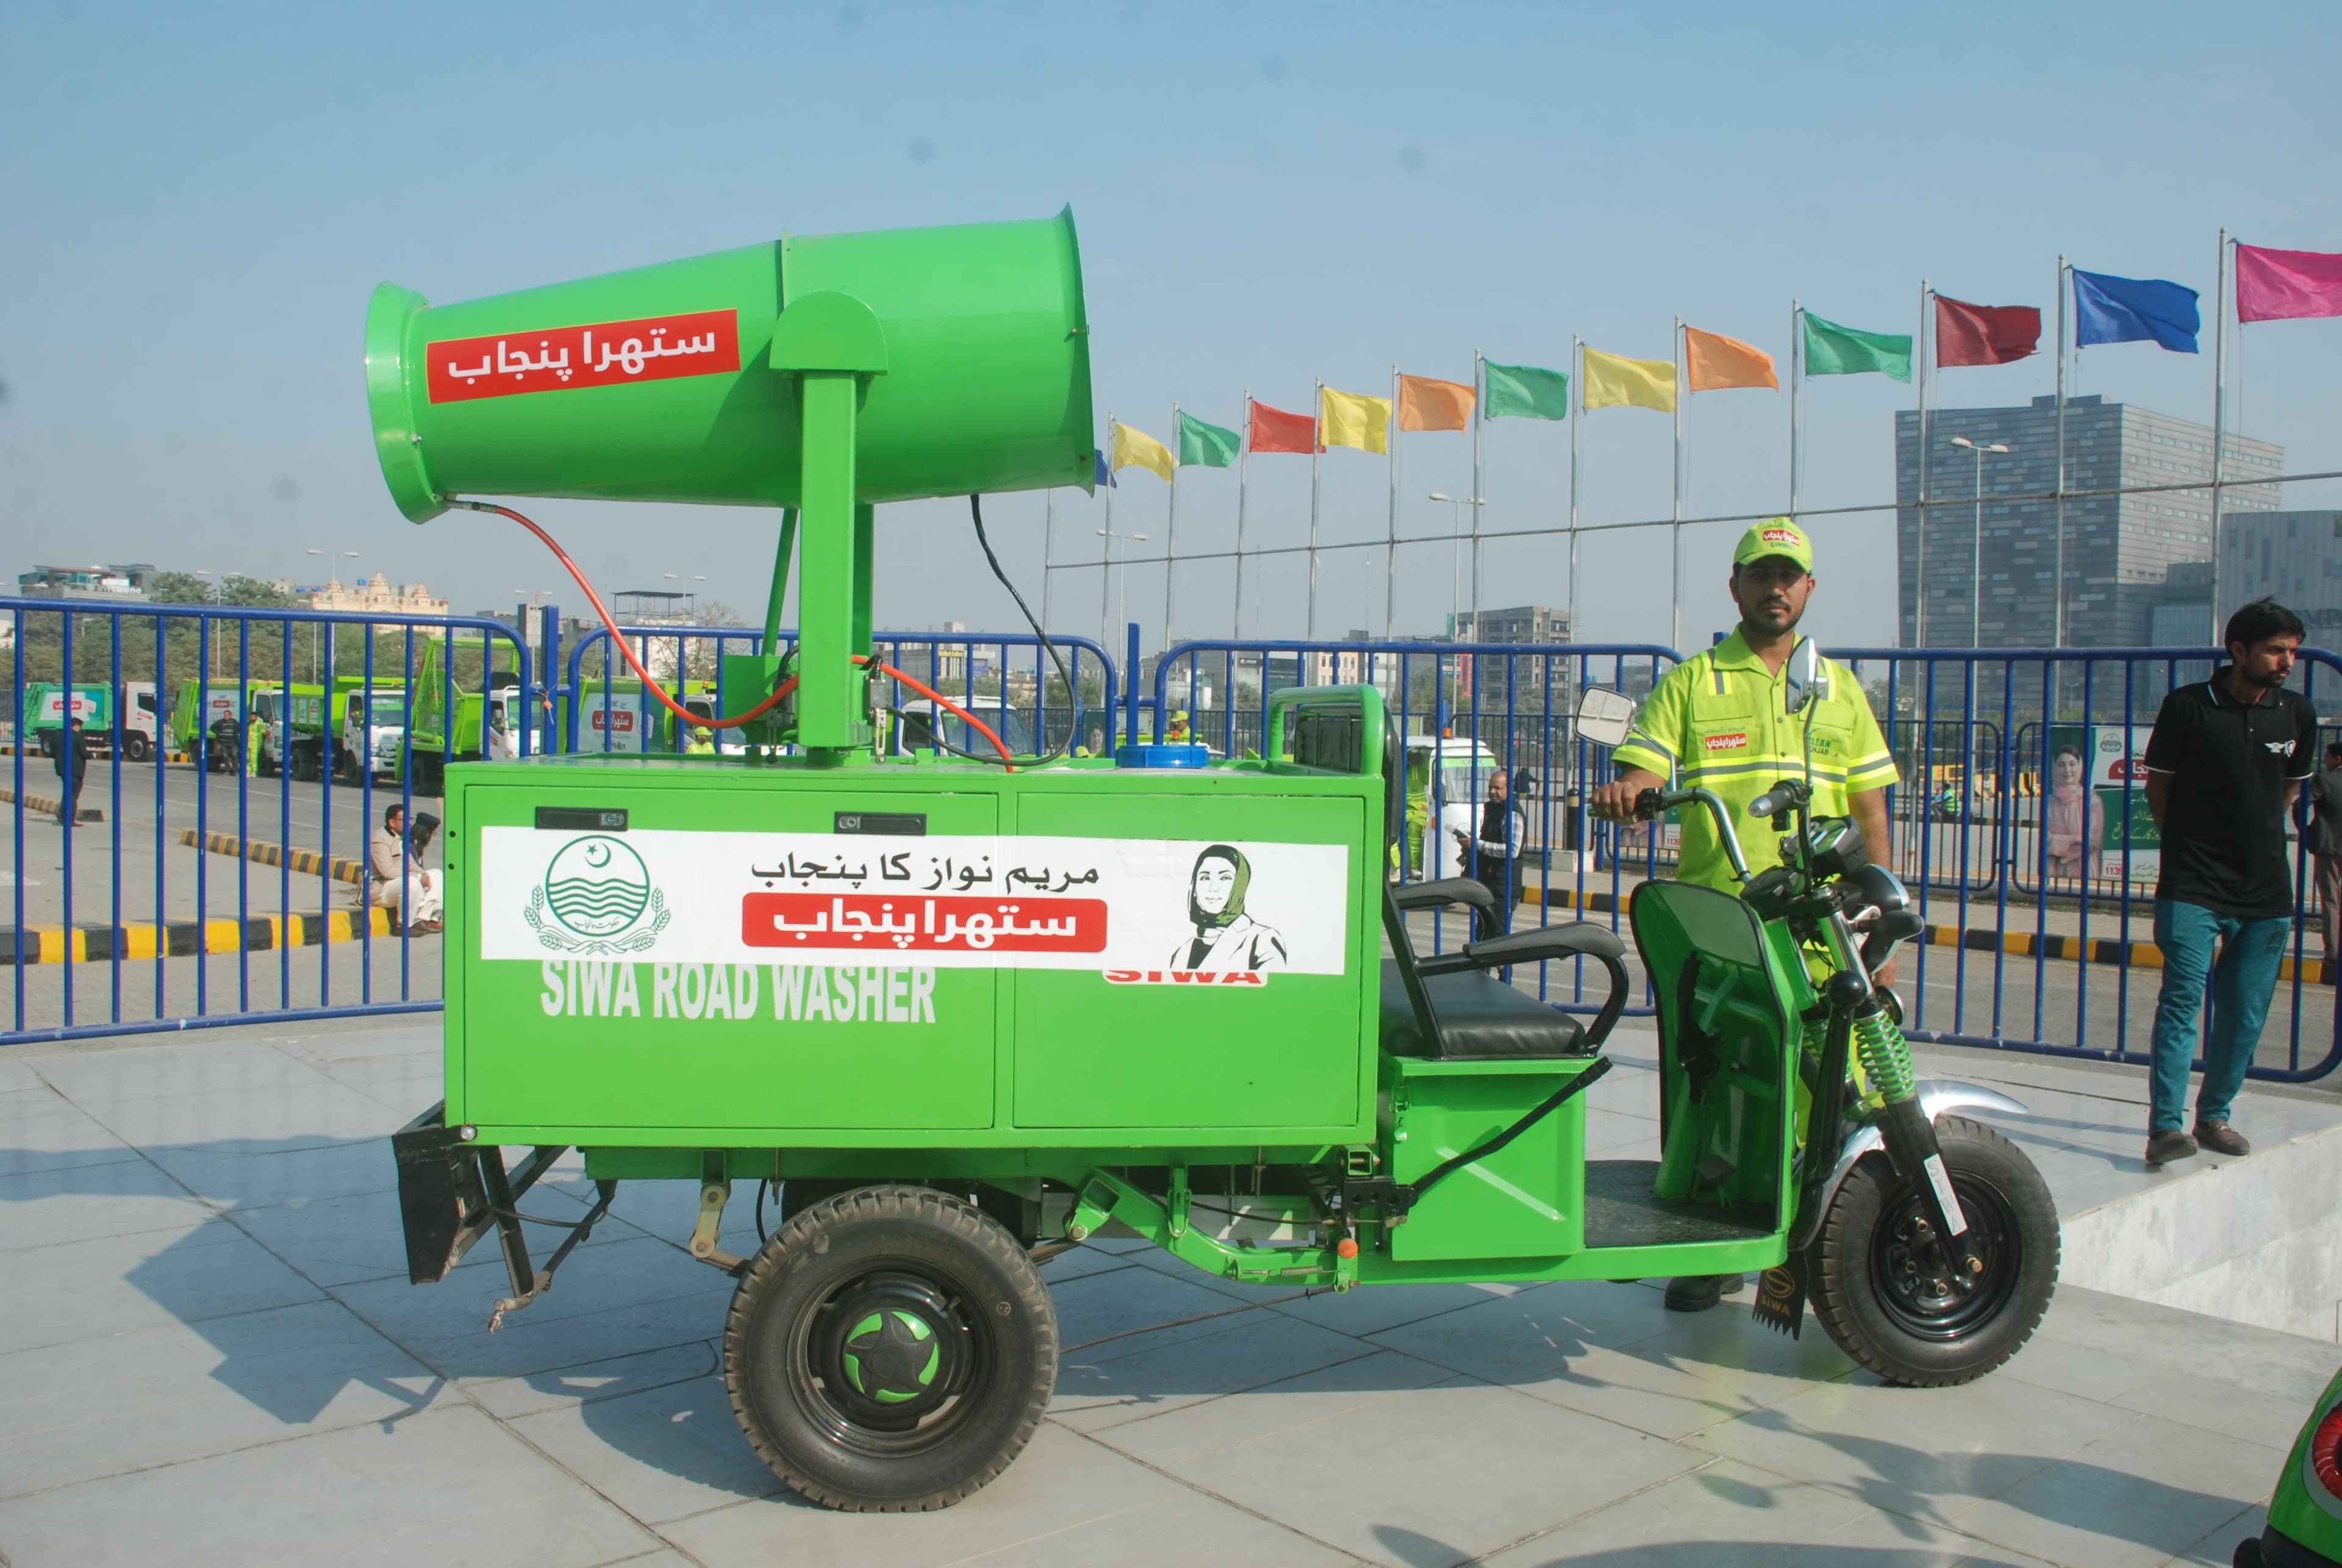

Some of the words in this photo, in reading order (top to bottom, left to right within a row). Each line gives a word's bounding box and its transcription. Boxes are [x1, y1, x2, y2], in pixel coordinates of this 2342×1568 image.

[449, 341, 572, 384] پنجاب
[584, 328, 715, 374] ستھرا
[751, 852, 867, 889] پنجاب
[880, 853, 911, 881] کا
[922, 856, 992, 891] نواز
[1006, 867, 1099, 895] مریم
[773, 898, 915, 949] پنجاب
[924, 900, 1076, 949] ستھرا
[541, 961, 640, 1017] SIWA
[654, 962, 759, 1020] ROAD
[771, 965, 936, 1023] WASHER
[1761, 1294, 1790, 1316] SIWA
